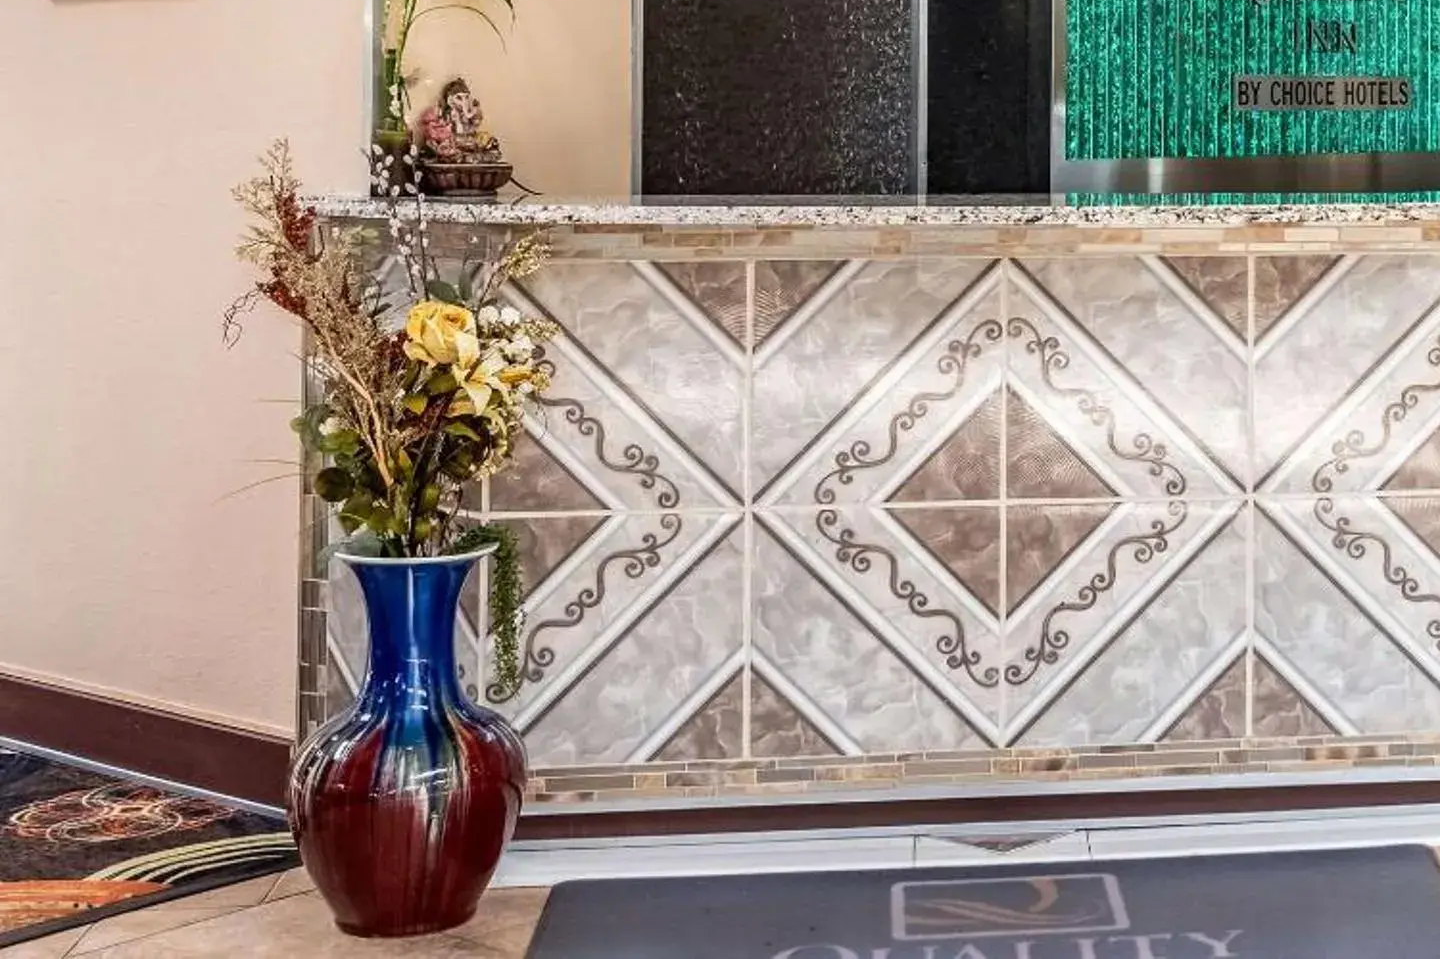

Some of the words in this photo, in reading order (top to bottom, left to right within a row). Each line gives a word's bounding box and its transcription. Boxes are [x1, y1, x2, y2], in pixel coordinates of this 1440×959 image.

[1293, 18, 1357, 54] INN
[1238, 81, 1262, 106] BY
[1270, 81, 1335, 106] CHOICE
[1344, 81, 1409, 106] HOTELS
